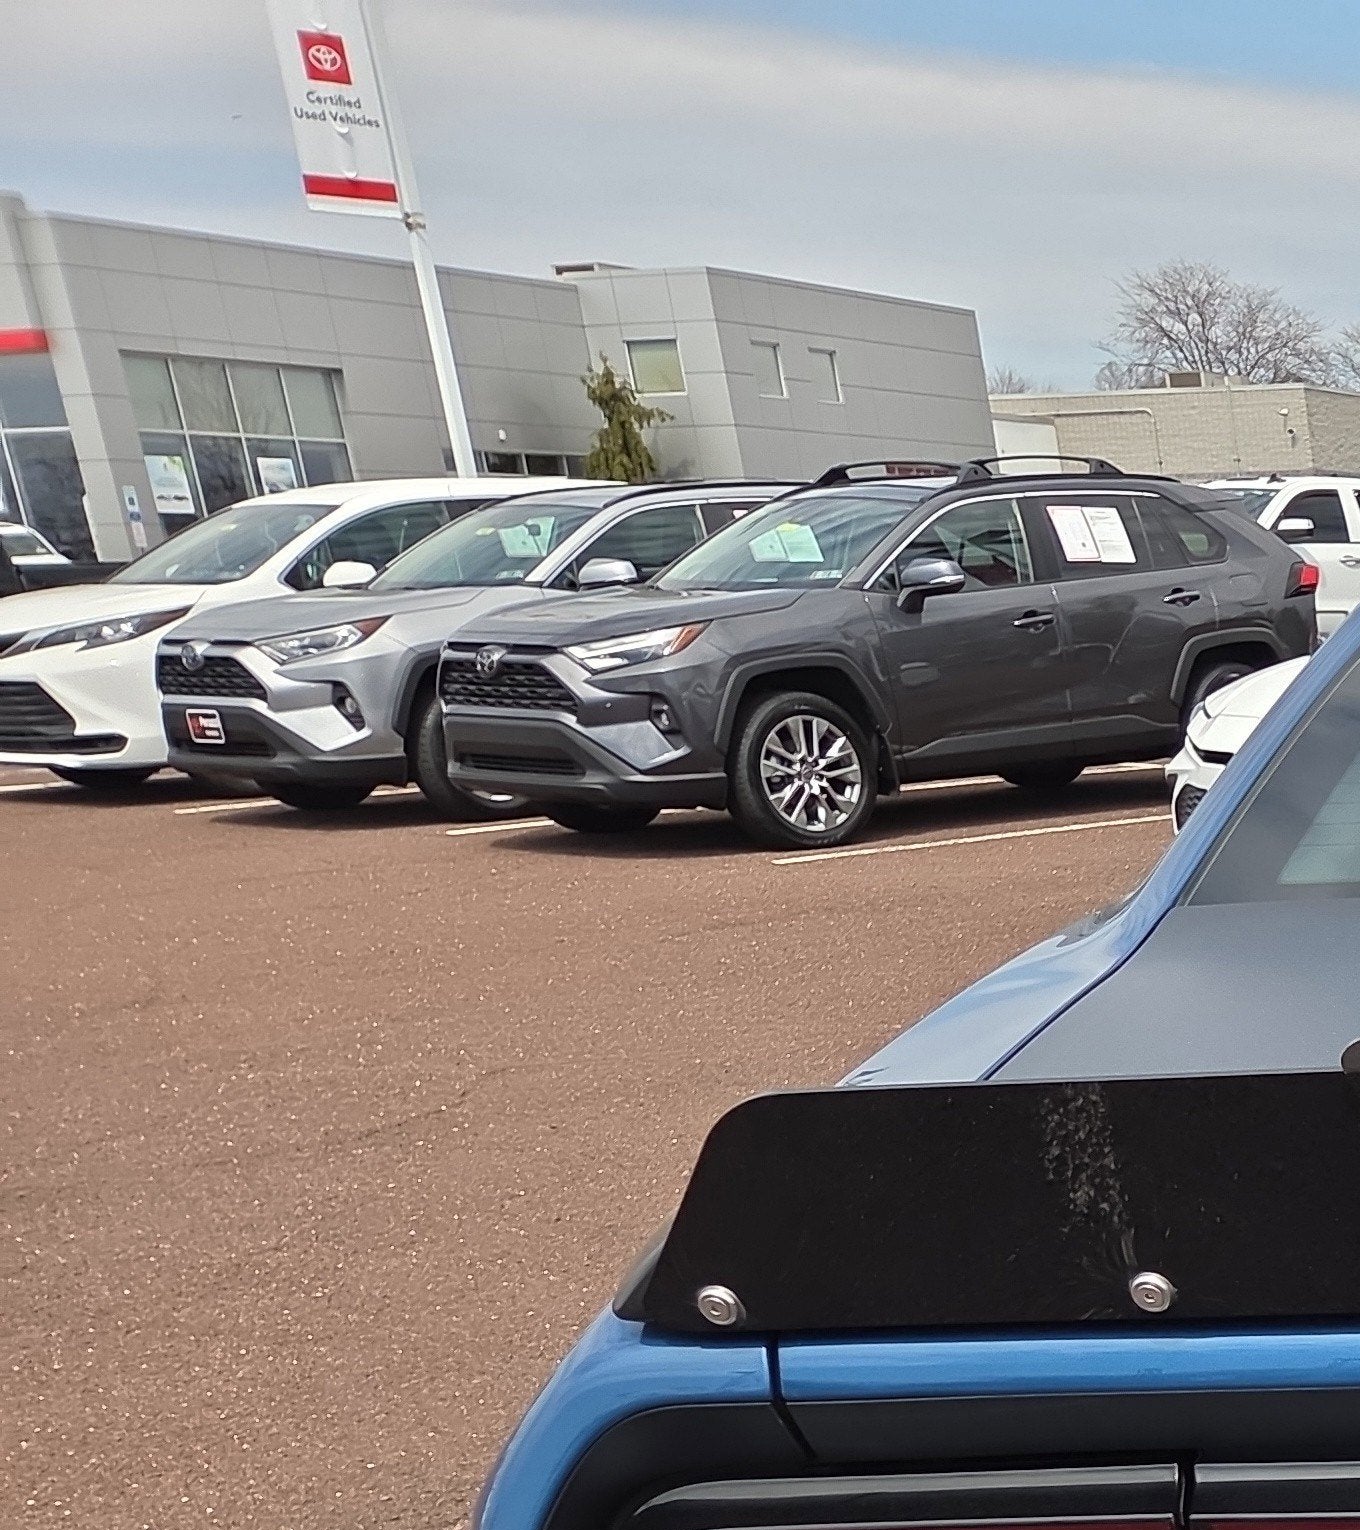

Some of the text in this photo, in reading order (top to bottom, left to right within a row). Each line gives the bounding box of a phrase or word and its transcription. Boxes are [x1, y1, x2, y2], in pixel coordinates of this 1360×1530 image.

[306, 90, 361, 109] Certified
[294, 106, 380, 128] Used Vehicles
